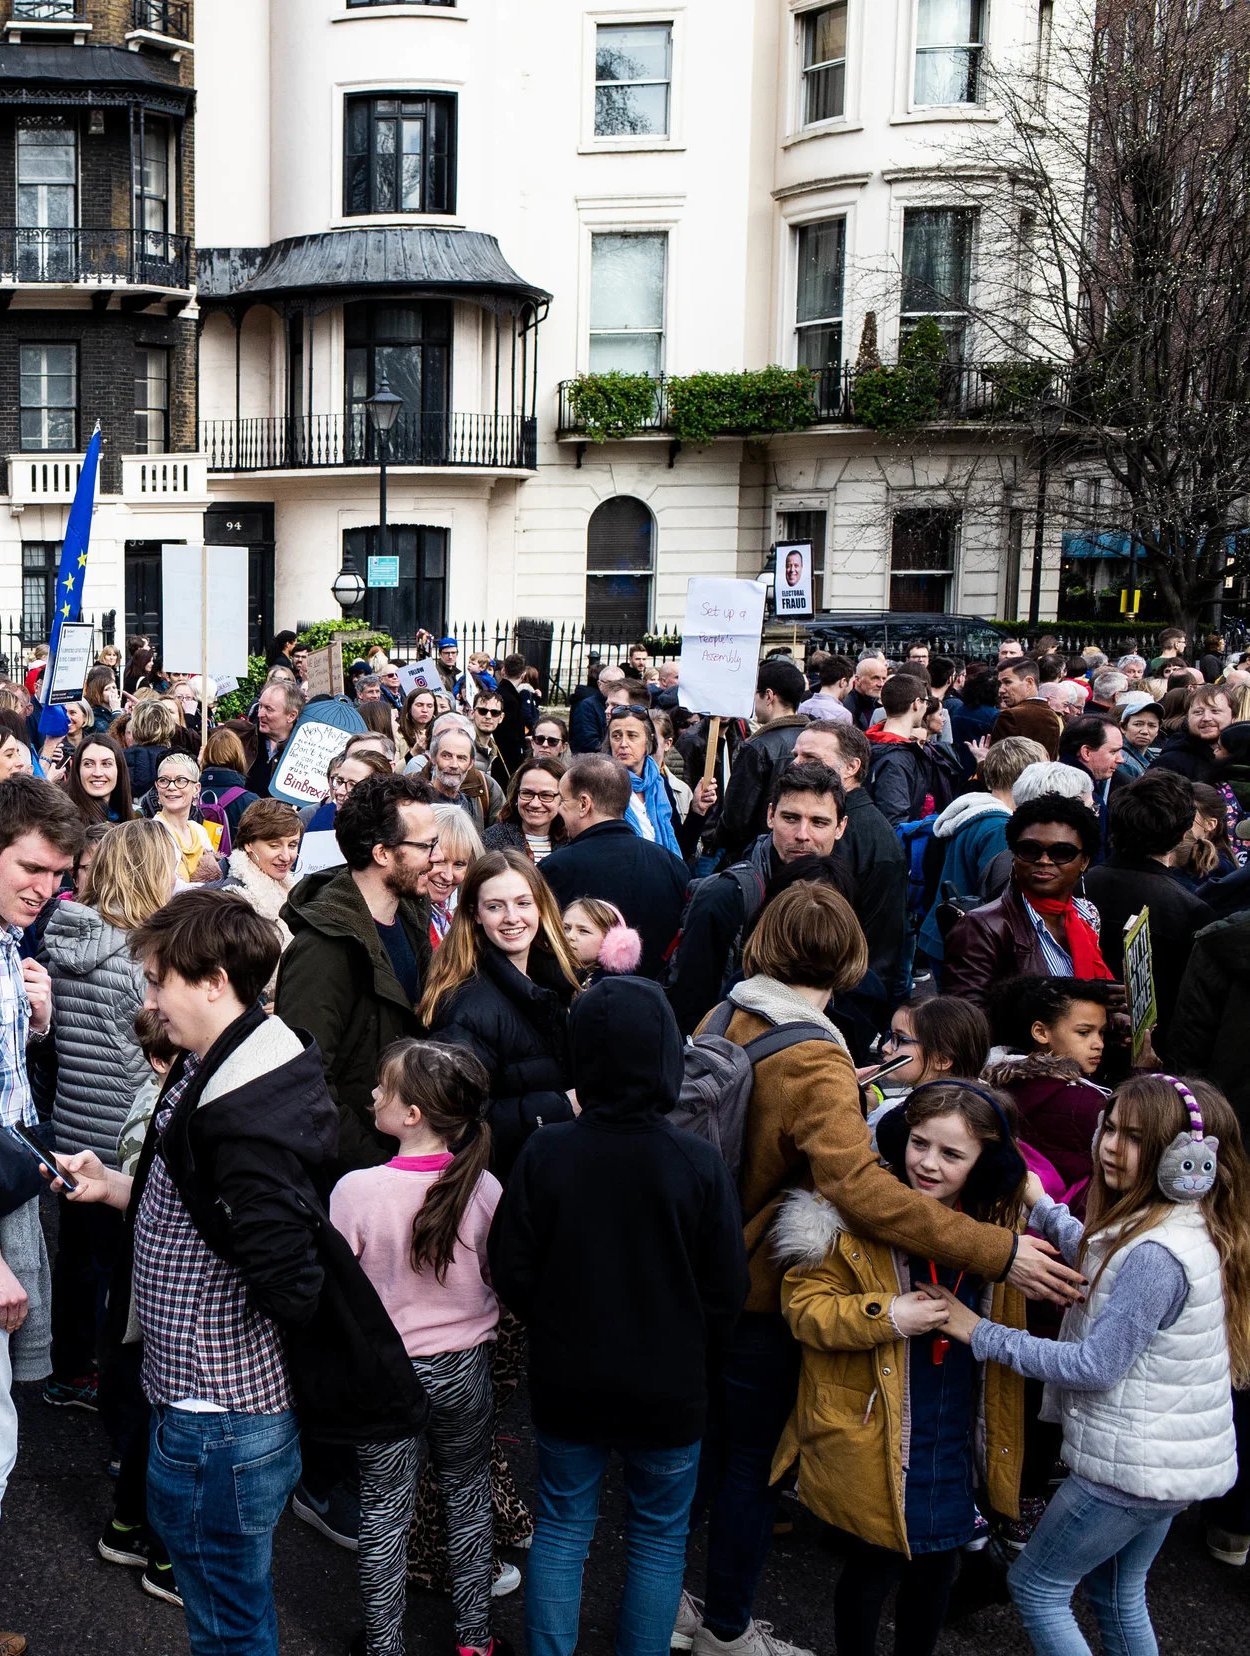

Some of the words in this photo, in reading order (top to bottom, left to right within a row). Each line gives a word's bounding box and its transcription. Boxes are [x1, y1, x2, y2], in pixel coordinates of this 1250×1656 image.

[226, 521, 242, 531] 94
[782, 597, 806, 609] FRAUD
[701, 601, 721, 617] Set
[723, 608, 735, 621] up
